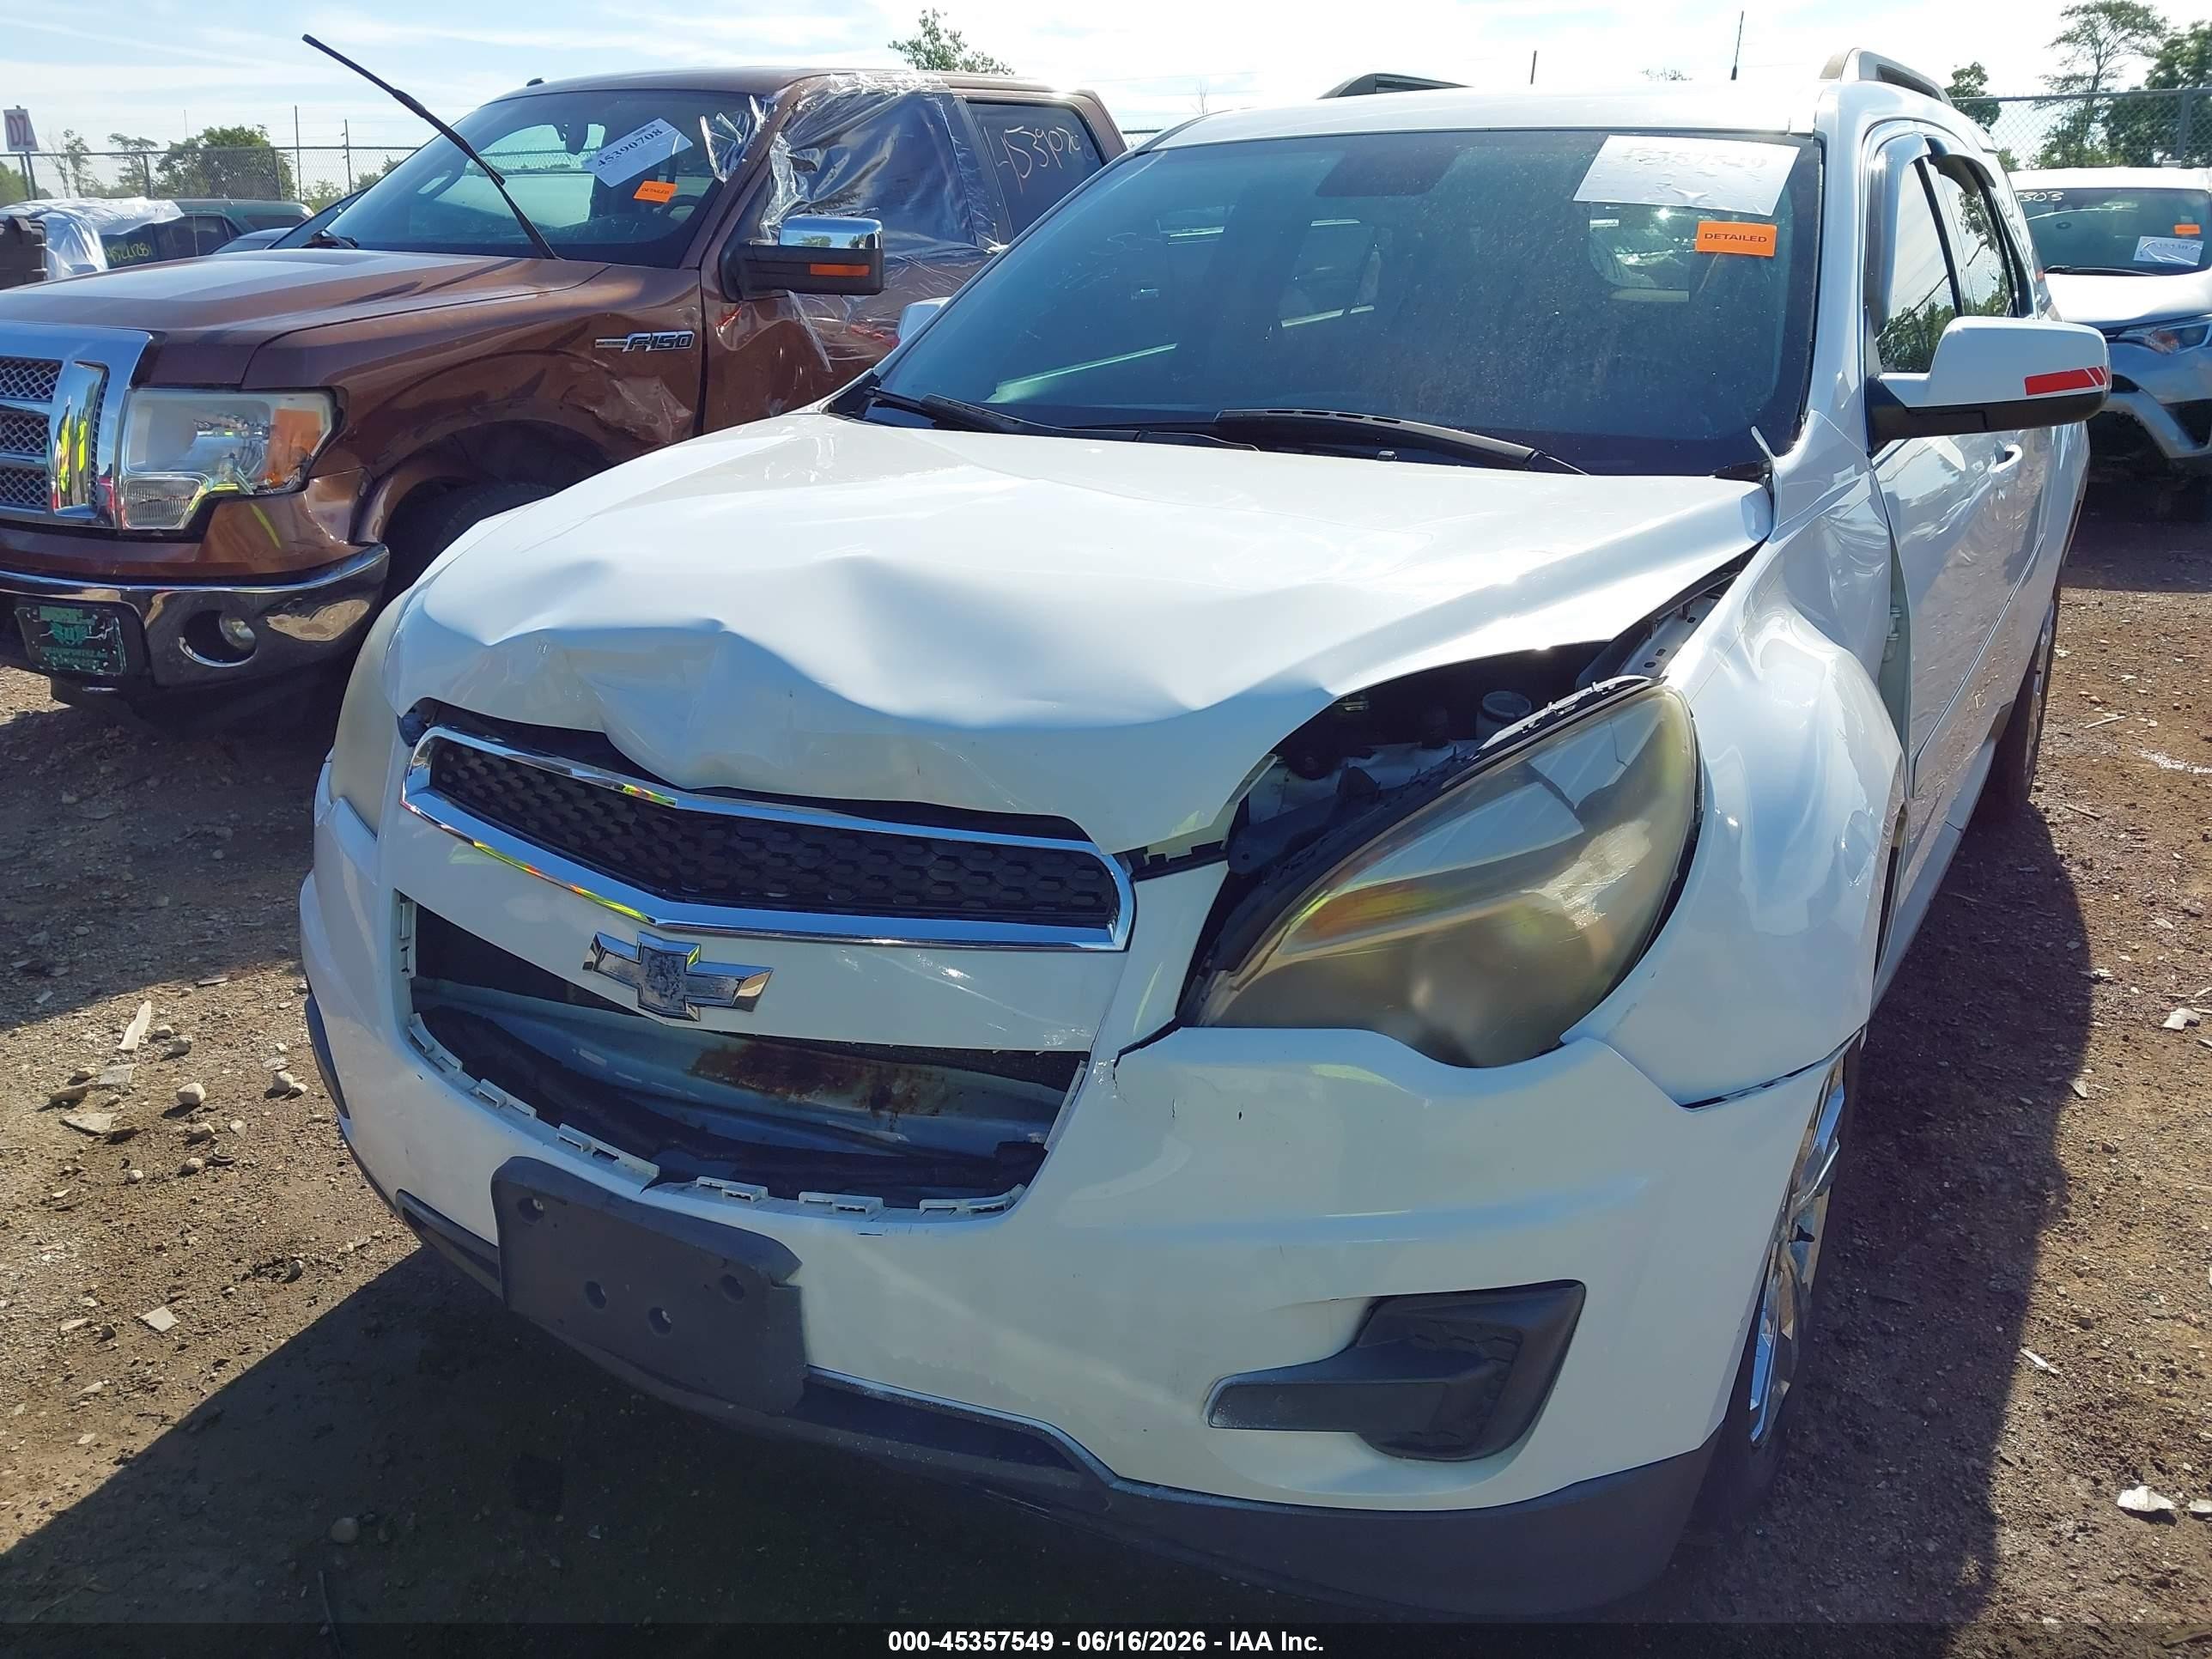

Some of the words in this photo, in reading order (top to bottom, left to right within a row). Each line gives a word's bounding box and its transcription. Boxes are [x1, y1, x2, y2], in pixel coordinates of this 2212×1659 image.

[598, 129, 663, 167] 45390708
[2015, 191, 2064, 202] 303
[1705, 233, 1767, 243] DETAILED
